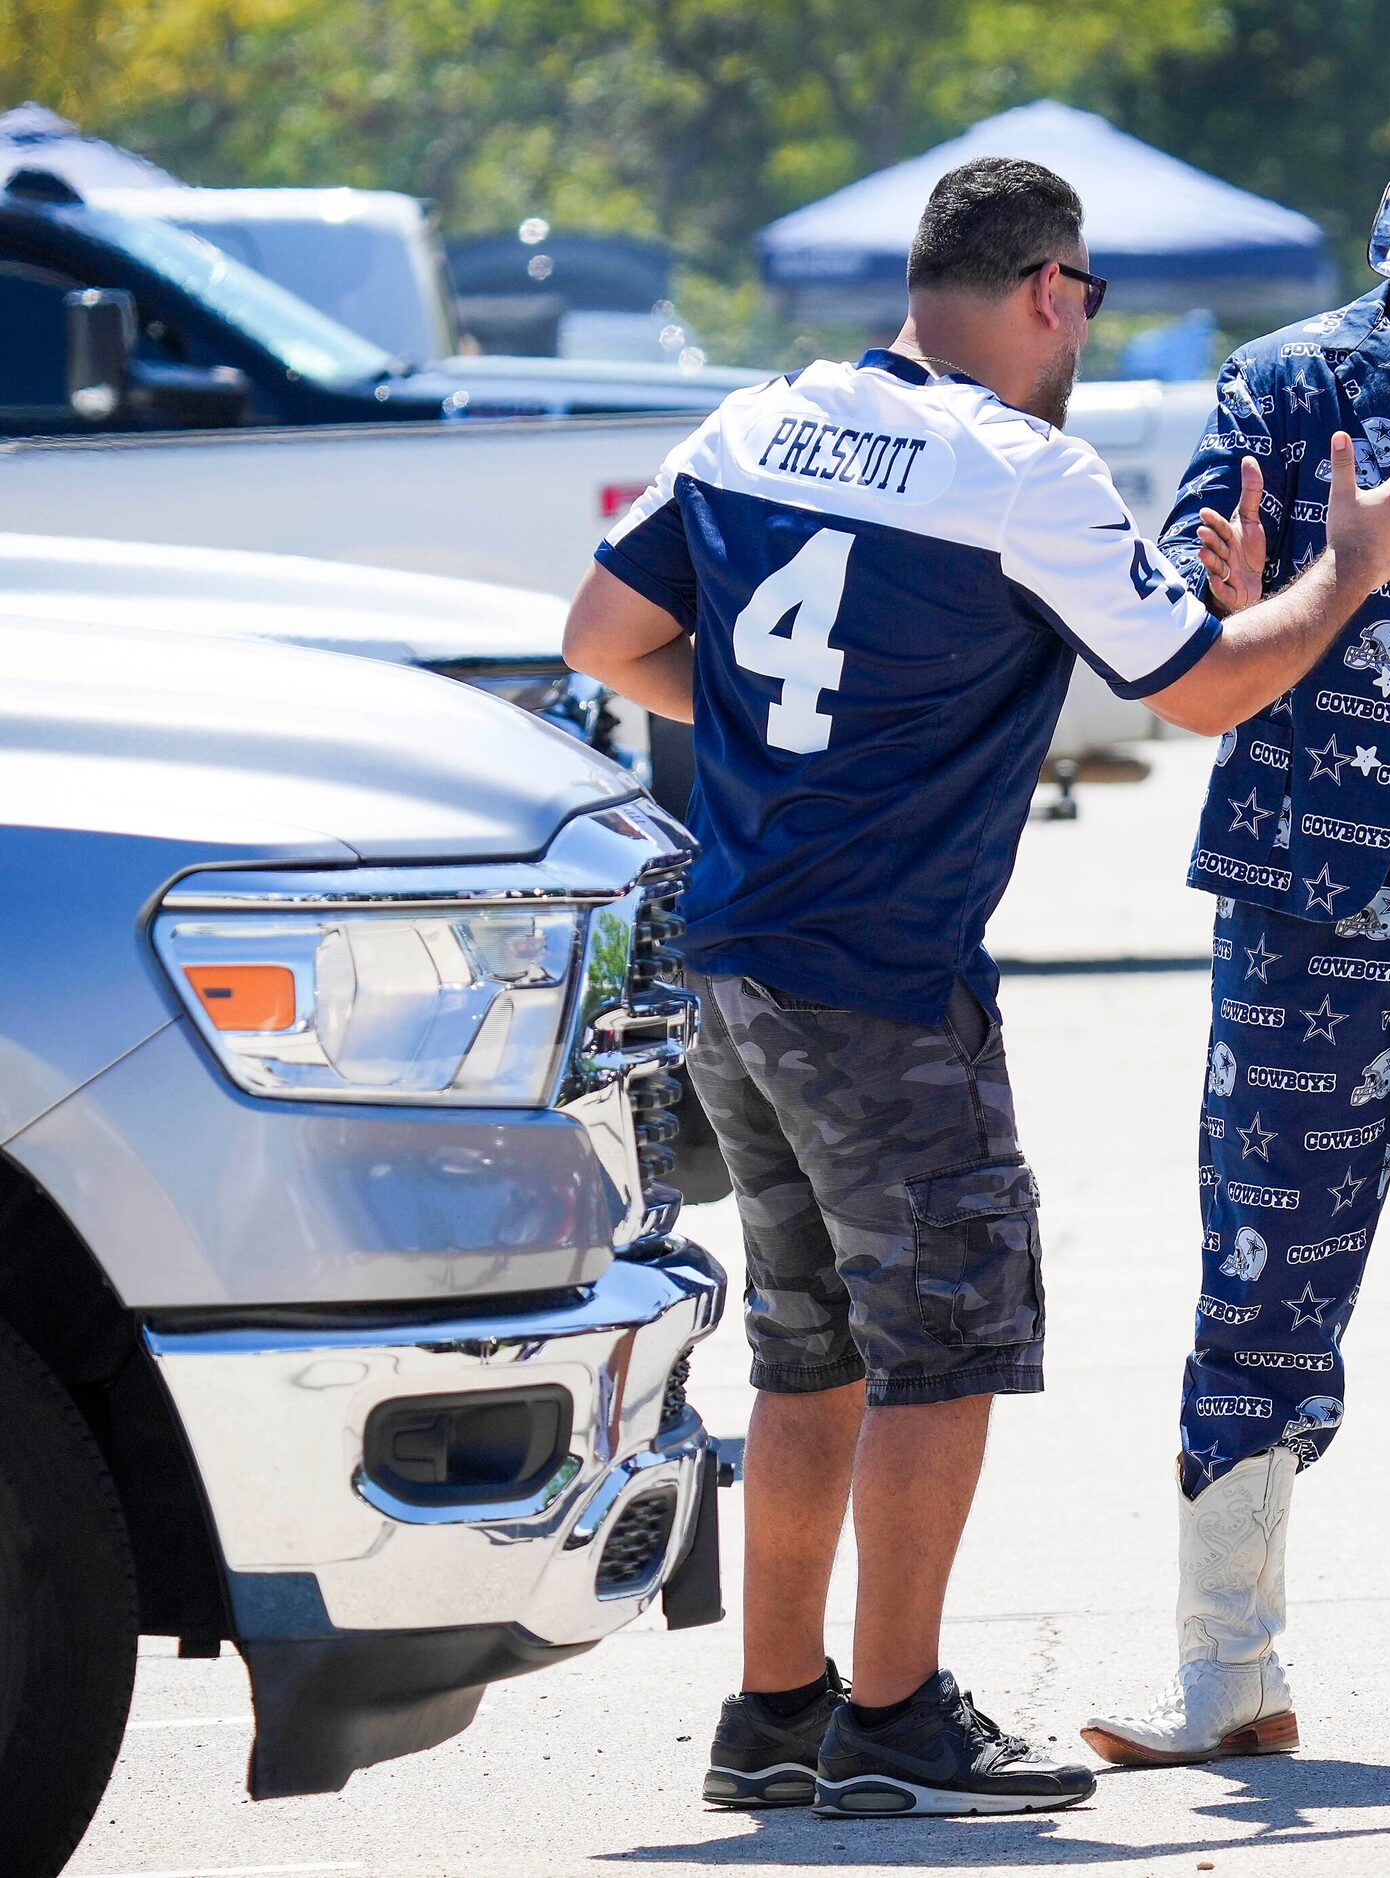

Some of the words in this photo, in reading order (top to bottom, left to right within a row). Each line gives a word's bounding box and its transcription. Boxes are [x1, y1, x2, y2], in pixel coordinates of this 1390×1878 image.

[758, 416, 927, 495] PRESCOTT
[1130, 538, 1187, 604] 4
[732, 527, 856, 754] 4
[1220, 998, 1286, 1028] COWBOYS
[1248, 1065, 1337, 1092] COWBOYS
[1304, 1118, 1386, 1151] COWBOYS
[1227, 1181, 1300, 1209] COWBOYS
[1287, 1228, 1367, 1265] COWBOYS
[1234, 1351, 1334, 1371] COWBOYS
[1196, 1395, 1273, 1418] COWBOYS
